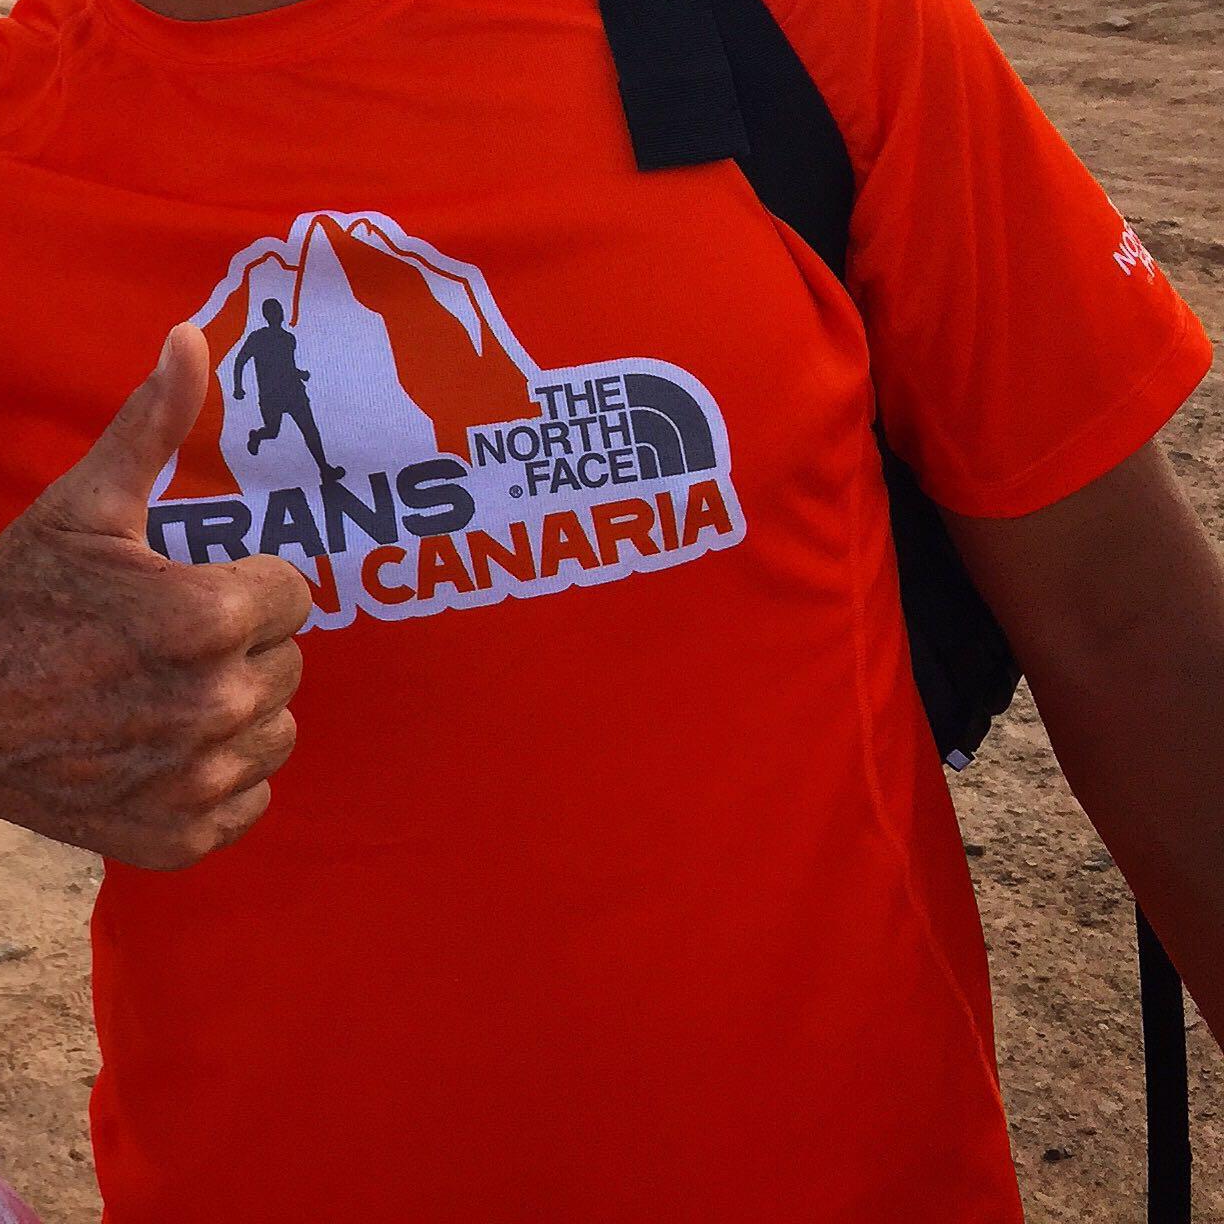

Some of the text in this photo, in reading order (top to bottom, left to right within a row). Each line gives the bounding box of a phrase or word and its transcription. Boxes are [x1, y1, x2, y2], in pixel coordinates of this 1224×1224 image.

[535, 376, 625, 419] THE
[474, 411, 632, 466] NORTH
[525, 447, 639, 496] FACE
[361, 478, 733, 605] CANARIA
